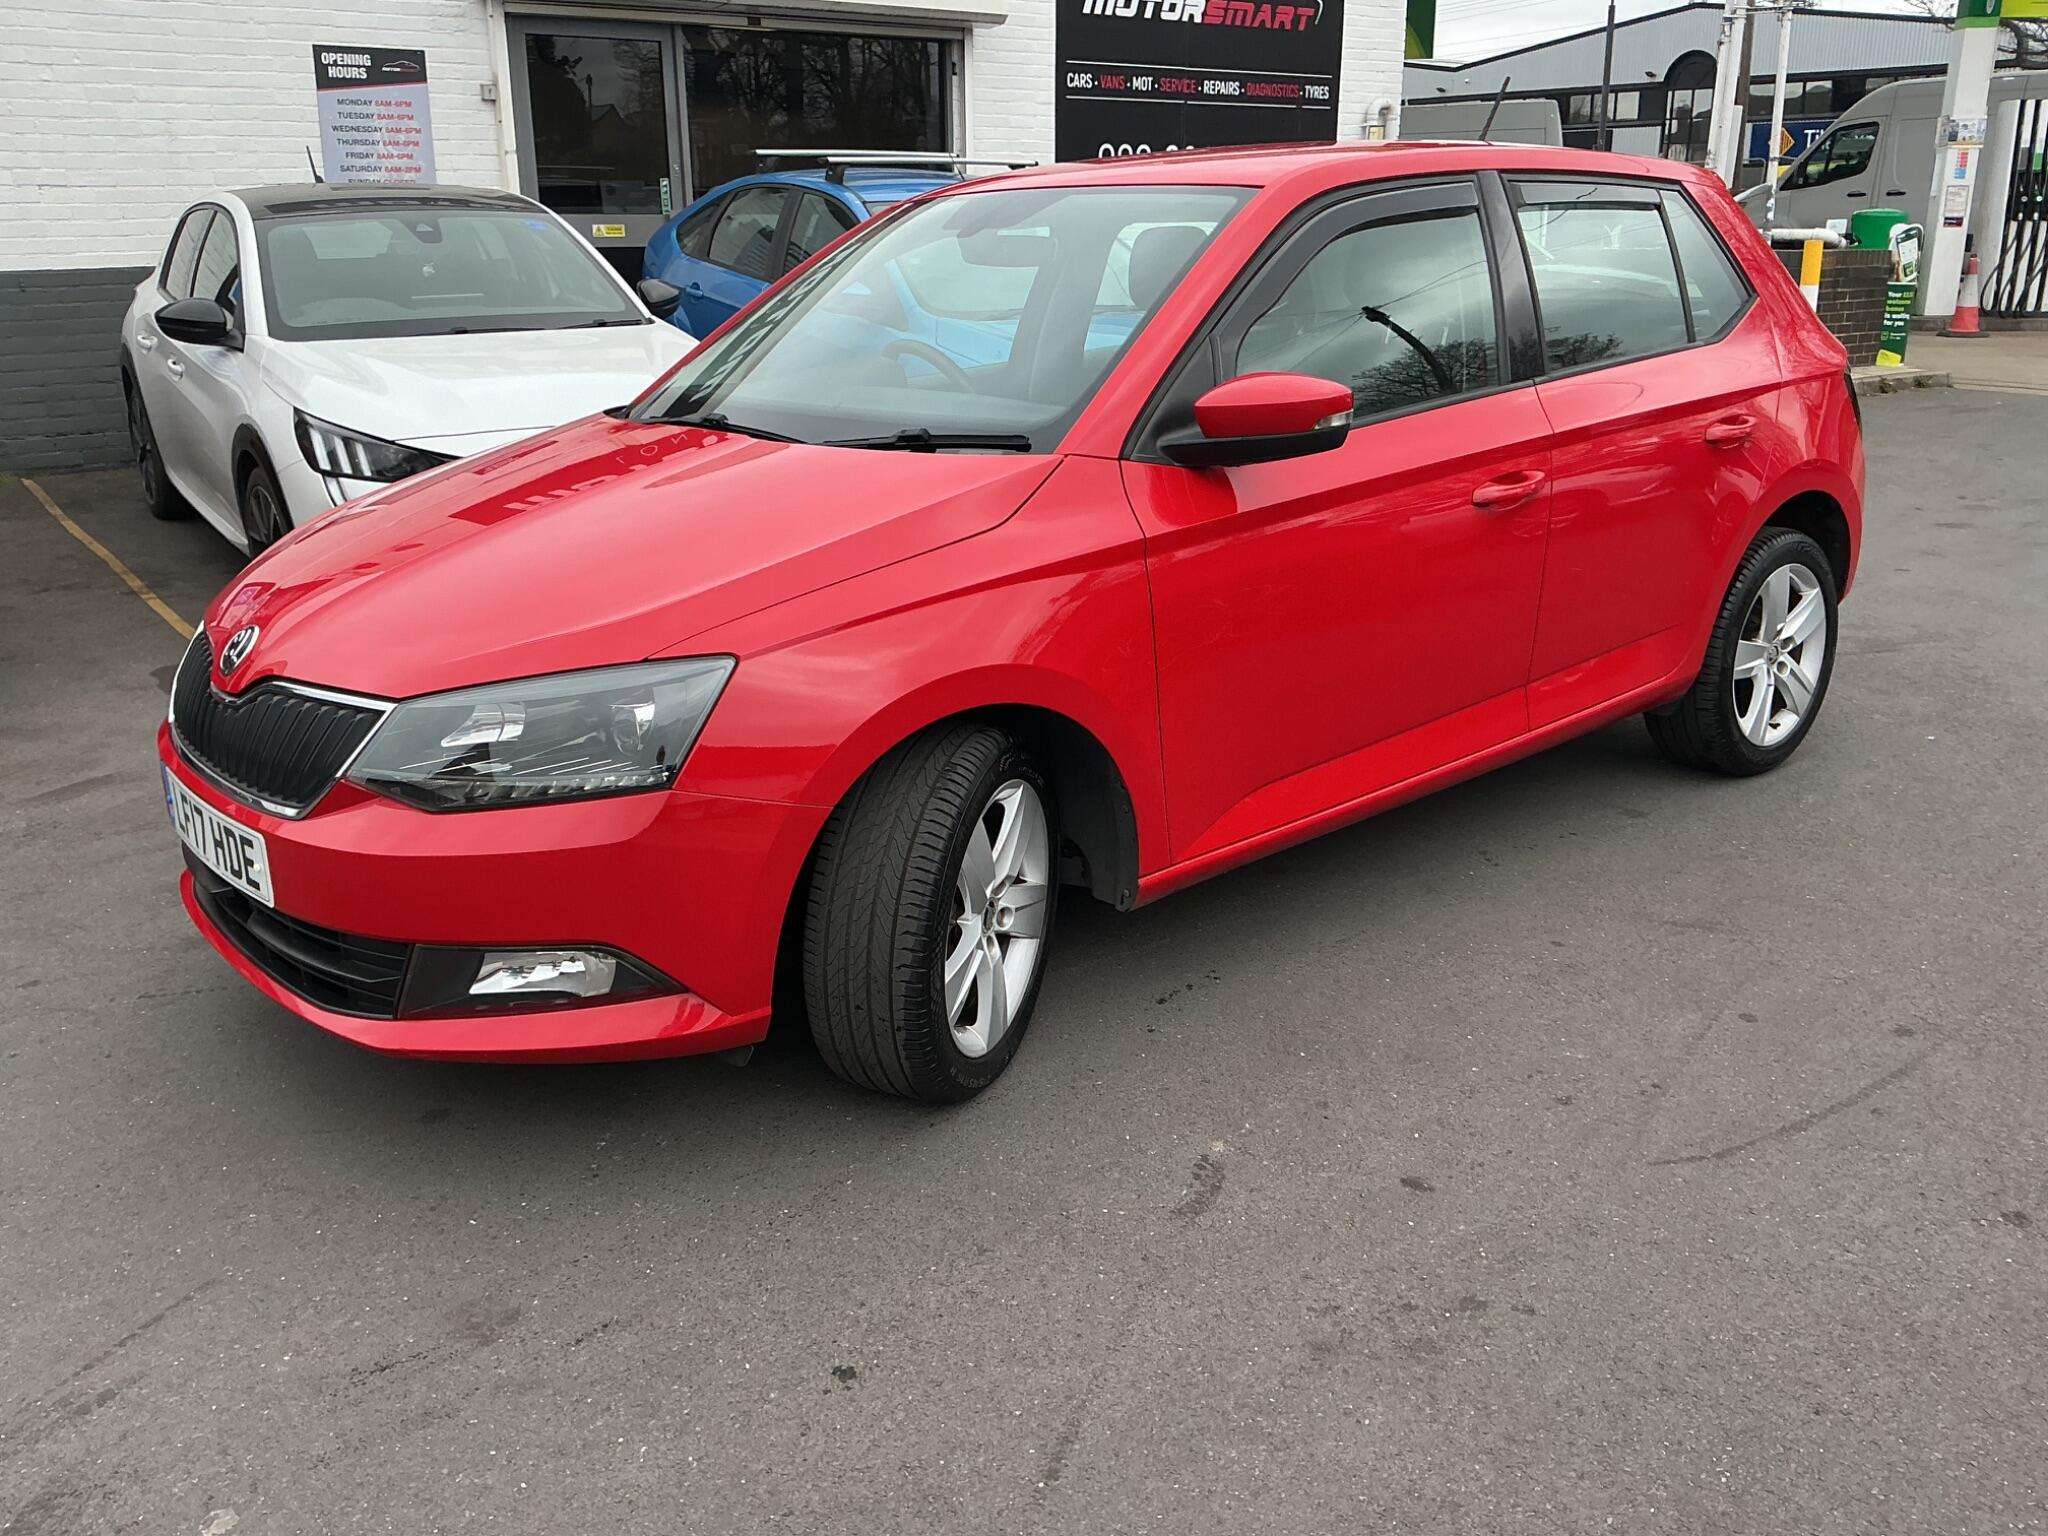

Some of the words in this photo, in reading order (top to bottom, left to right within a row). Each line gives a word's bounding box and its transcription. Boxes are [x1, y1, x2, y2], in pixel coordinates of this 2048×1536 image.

[1082, 0, 1316, 31] MOTORSMART
[321, 52, 371, 66] OPENING
[328, 66, 368, 79] HOURS
[1067, 72, 1093, 88] CARS
[1100, 75, 1125, 90] VANS
[1132, 76, 1153, 91] MOT
[1160, 77, 1196, 93] SERVICE
[1203, 80, 1240, 96] REPAIRS
[1246, 82, 1299, 98] DIAGNOSTICS
[1304, 85, 1330, 99] TYRES
[337, 98, 373, 106] MONDAY
[337, 112, 375, 120] TUESDAY
[332, 125, 383, 133] WEDNESDAY
[337, 138, 381, 146] THURSDAY
[176, 792, 206, 855] LF17
[209, 816, 260, 891] HDE
